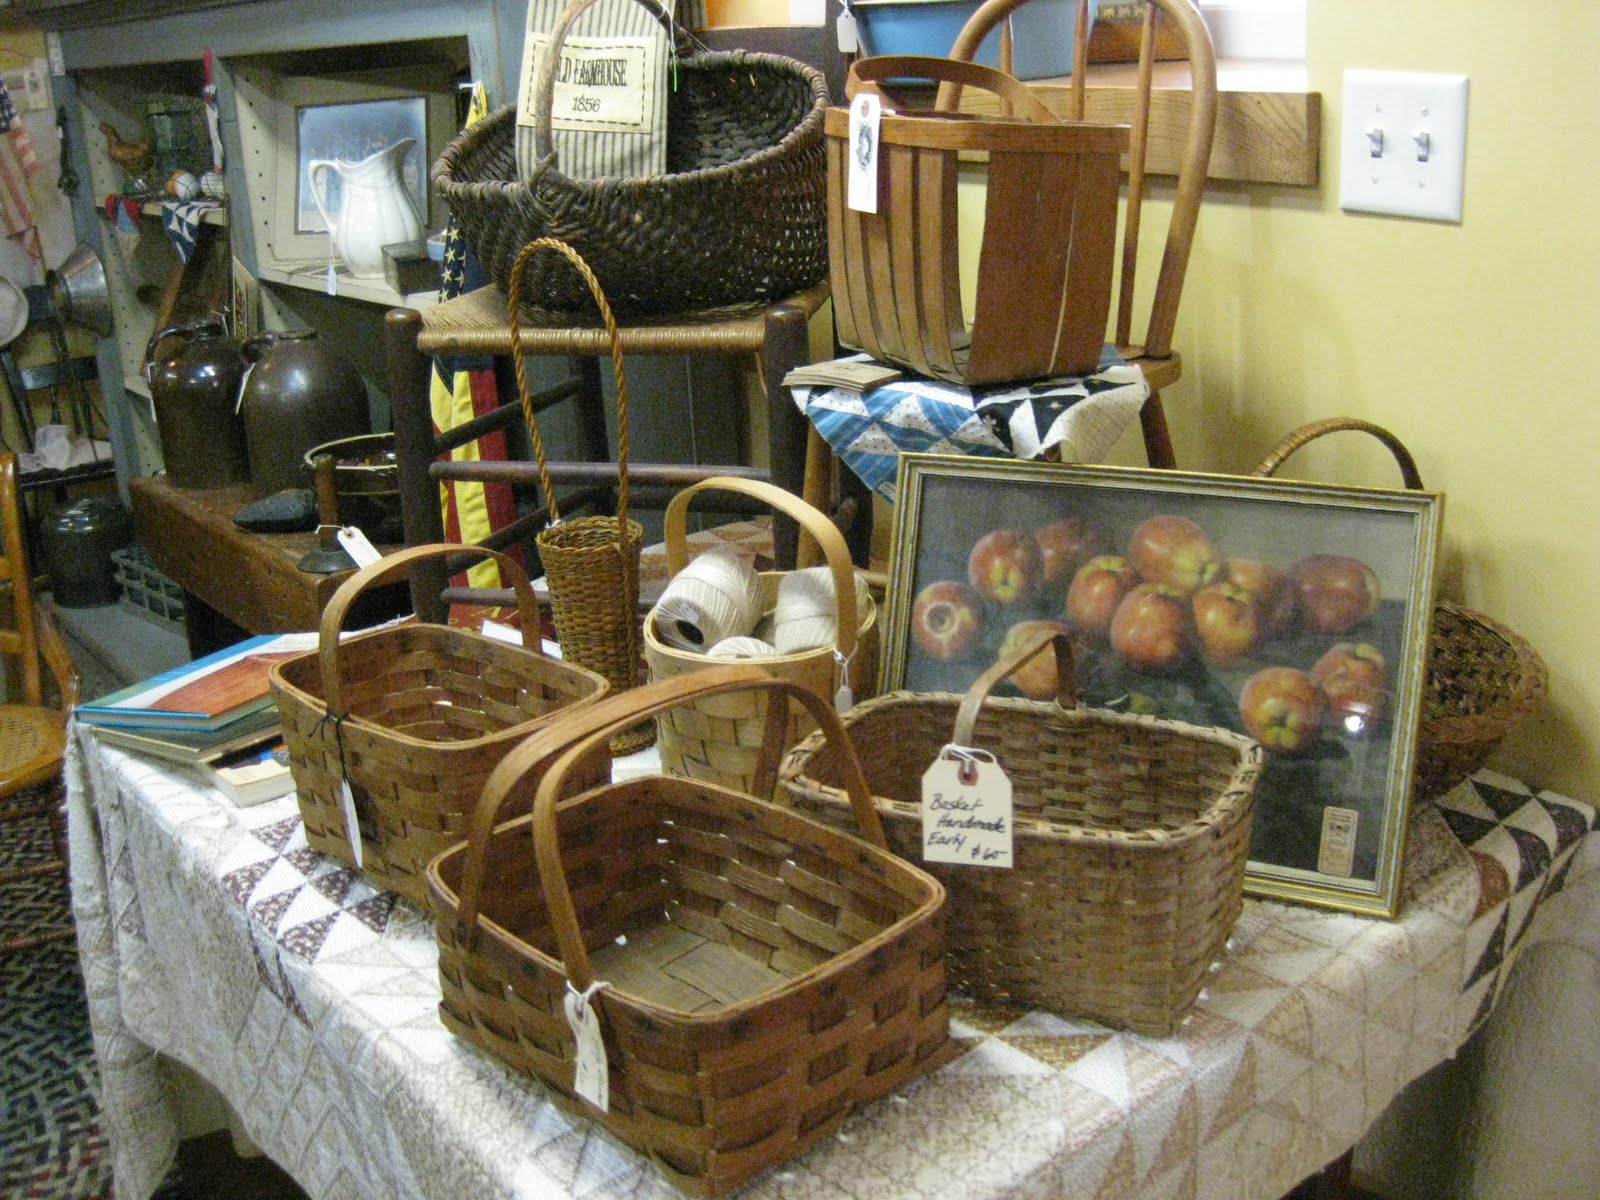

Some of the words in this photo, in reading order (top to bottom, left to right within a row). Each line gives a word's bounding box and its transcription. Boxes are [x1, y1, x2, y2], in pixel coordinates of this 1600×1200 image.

[556, 56, 572, 83] LD
[573, 58, 627, 87] FARMHOUSE
[572, 94, 601, 112] 1856
[929, 793, 983, 811] Basket
[937, 813, 1006, 833] Handmade
[926, 831, 967, 853] Early
